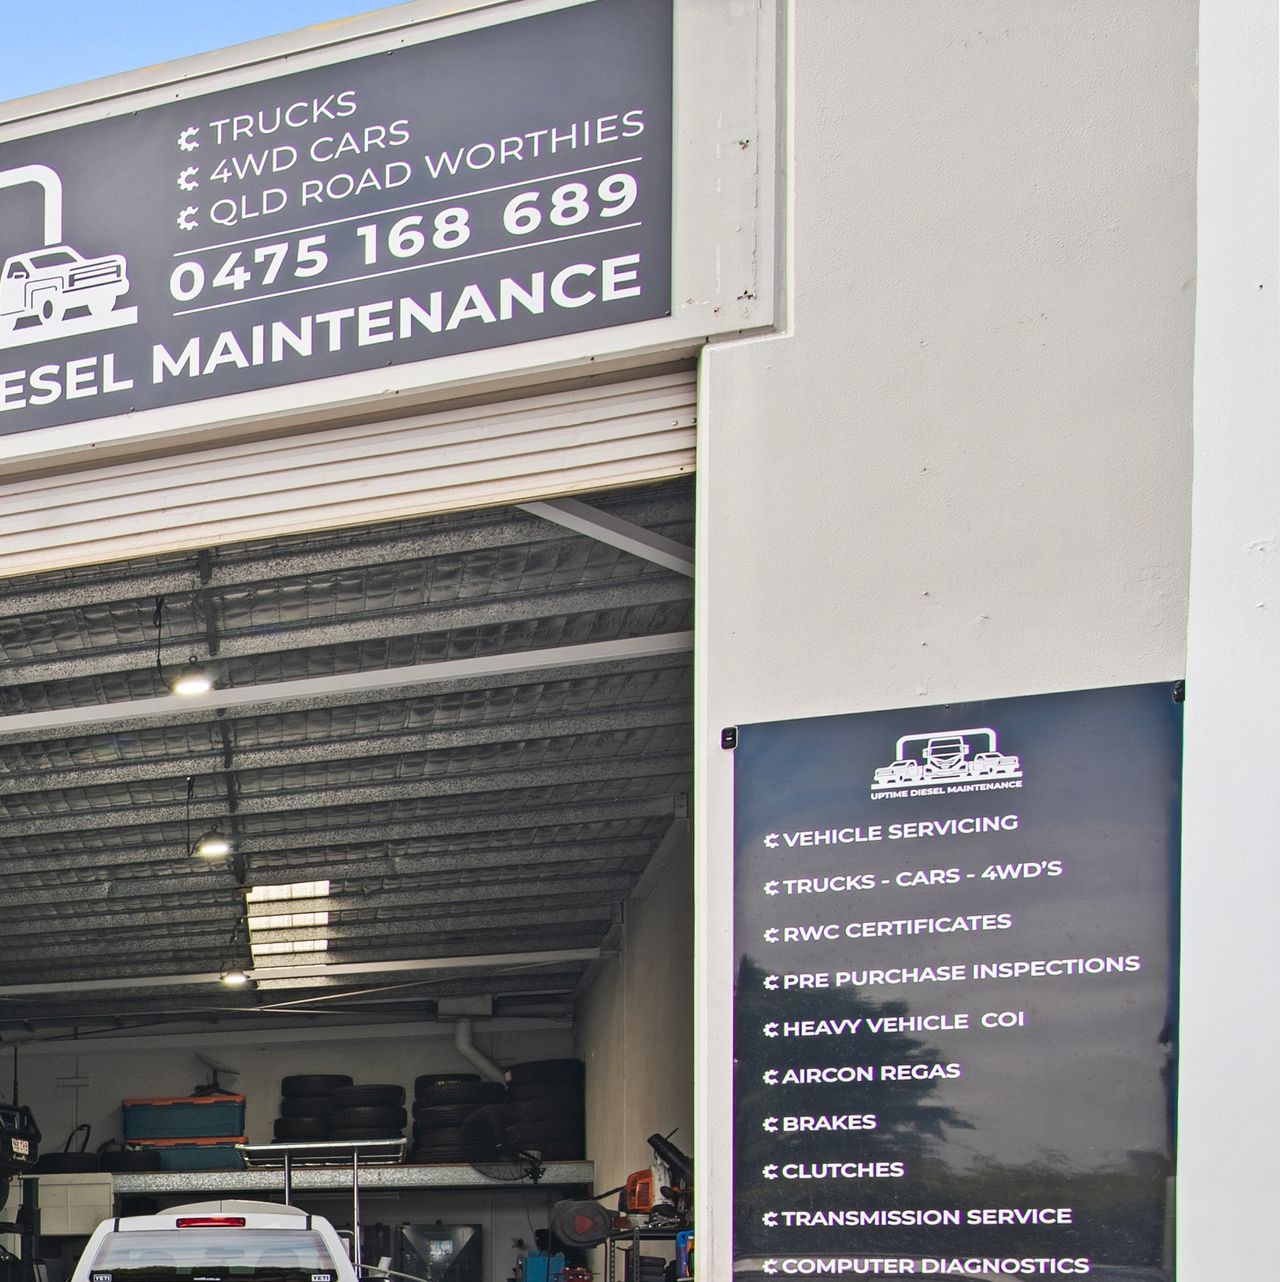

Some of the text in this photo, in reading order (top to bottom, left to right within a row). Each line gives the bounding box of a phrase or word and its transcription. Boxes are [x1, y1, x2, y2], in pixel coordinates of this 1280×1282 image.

[209, 90, 357, 143] TRUCKS
[210, 120, 409, 183] 4WD CARS
[210, 110, 644, 226] QLD ROAD WORTHIES
[170, 174, 637, 301] 0475 168 689
[152, 254, 642, 388] MAINTENANCE
[871, 780, 1022, 800] UPTIME DIESEL MAINTENANCE
[783, 815, 1018, 847] VEHICLE SERVICING
[783, 875, 875, 894] TRUCKS
[896, 869, 960, 886] CARS
[784, 914, 1011, 942] RWC CERTIFICATES
[784, 956, 1140, 989] PRE PURCHASE INSPECTIONS
[784, 1012, 1023, 1036] HEAVY VEHICLE COI
[782, 1063, 960, 1084] AIRCON REGAS
[784, 1115, 876, 1131] BRAKES
[782, 1162, 904, 1178] CLUTCHES
[782, 1209, 1072, 1226] TRANSMISSION SERVICE
[782, 1258, 1089, 1273] COMPUTER DIAGNOSTICS
